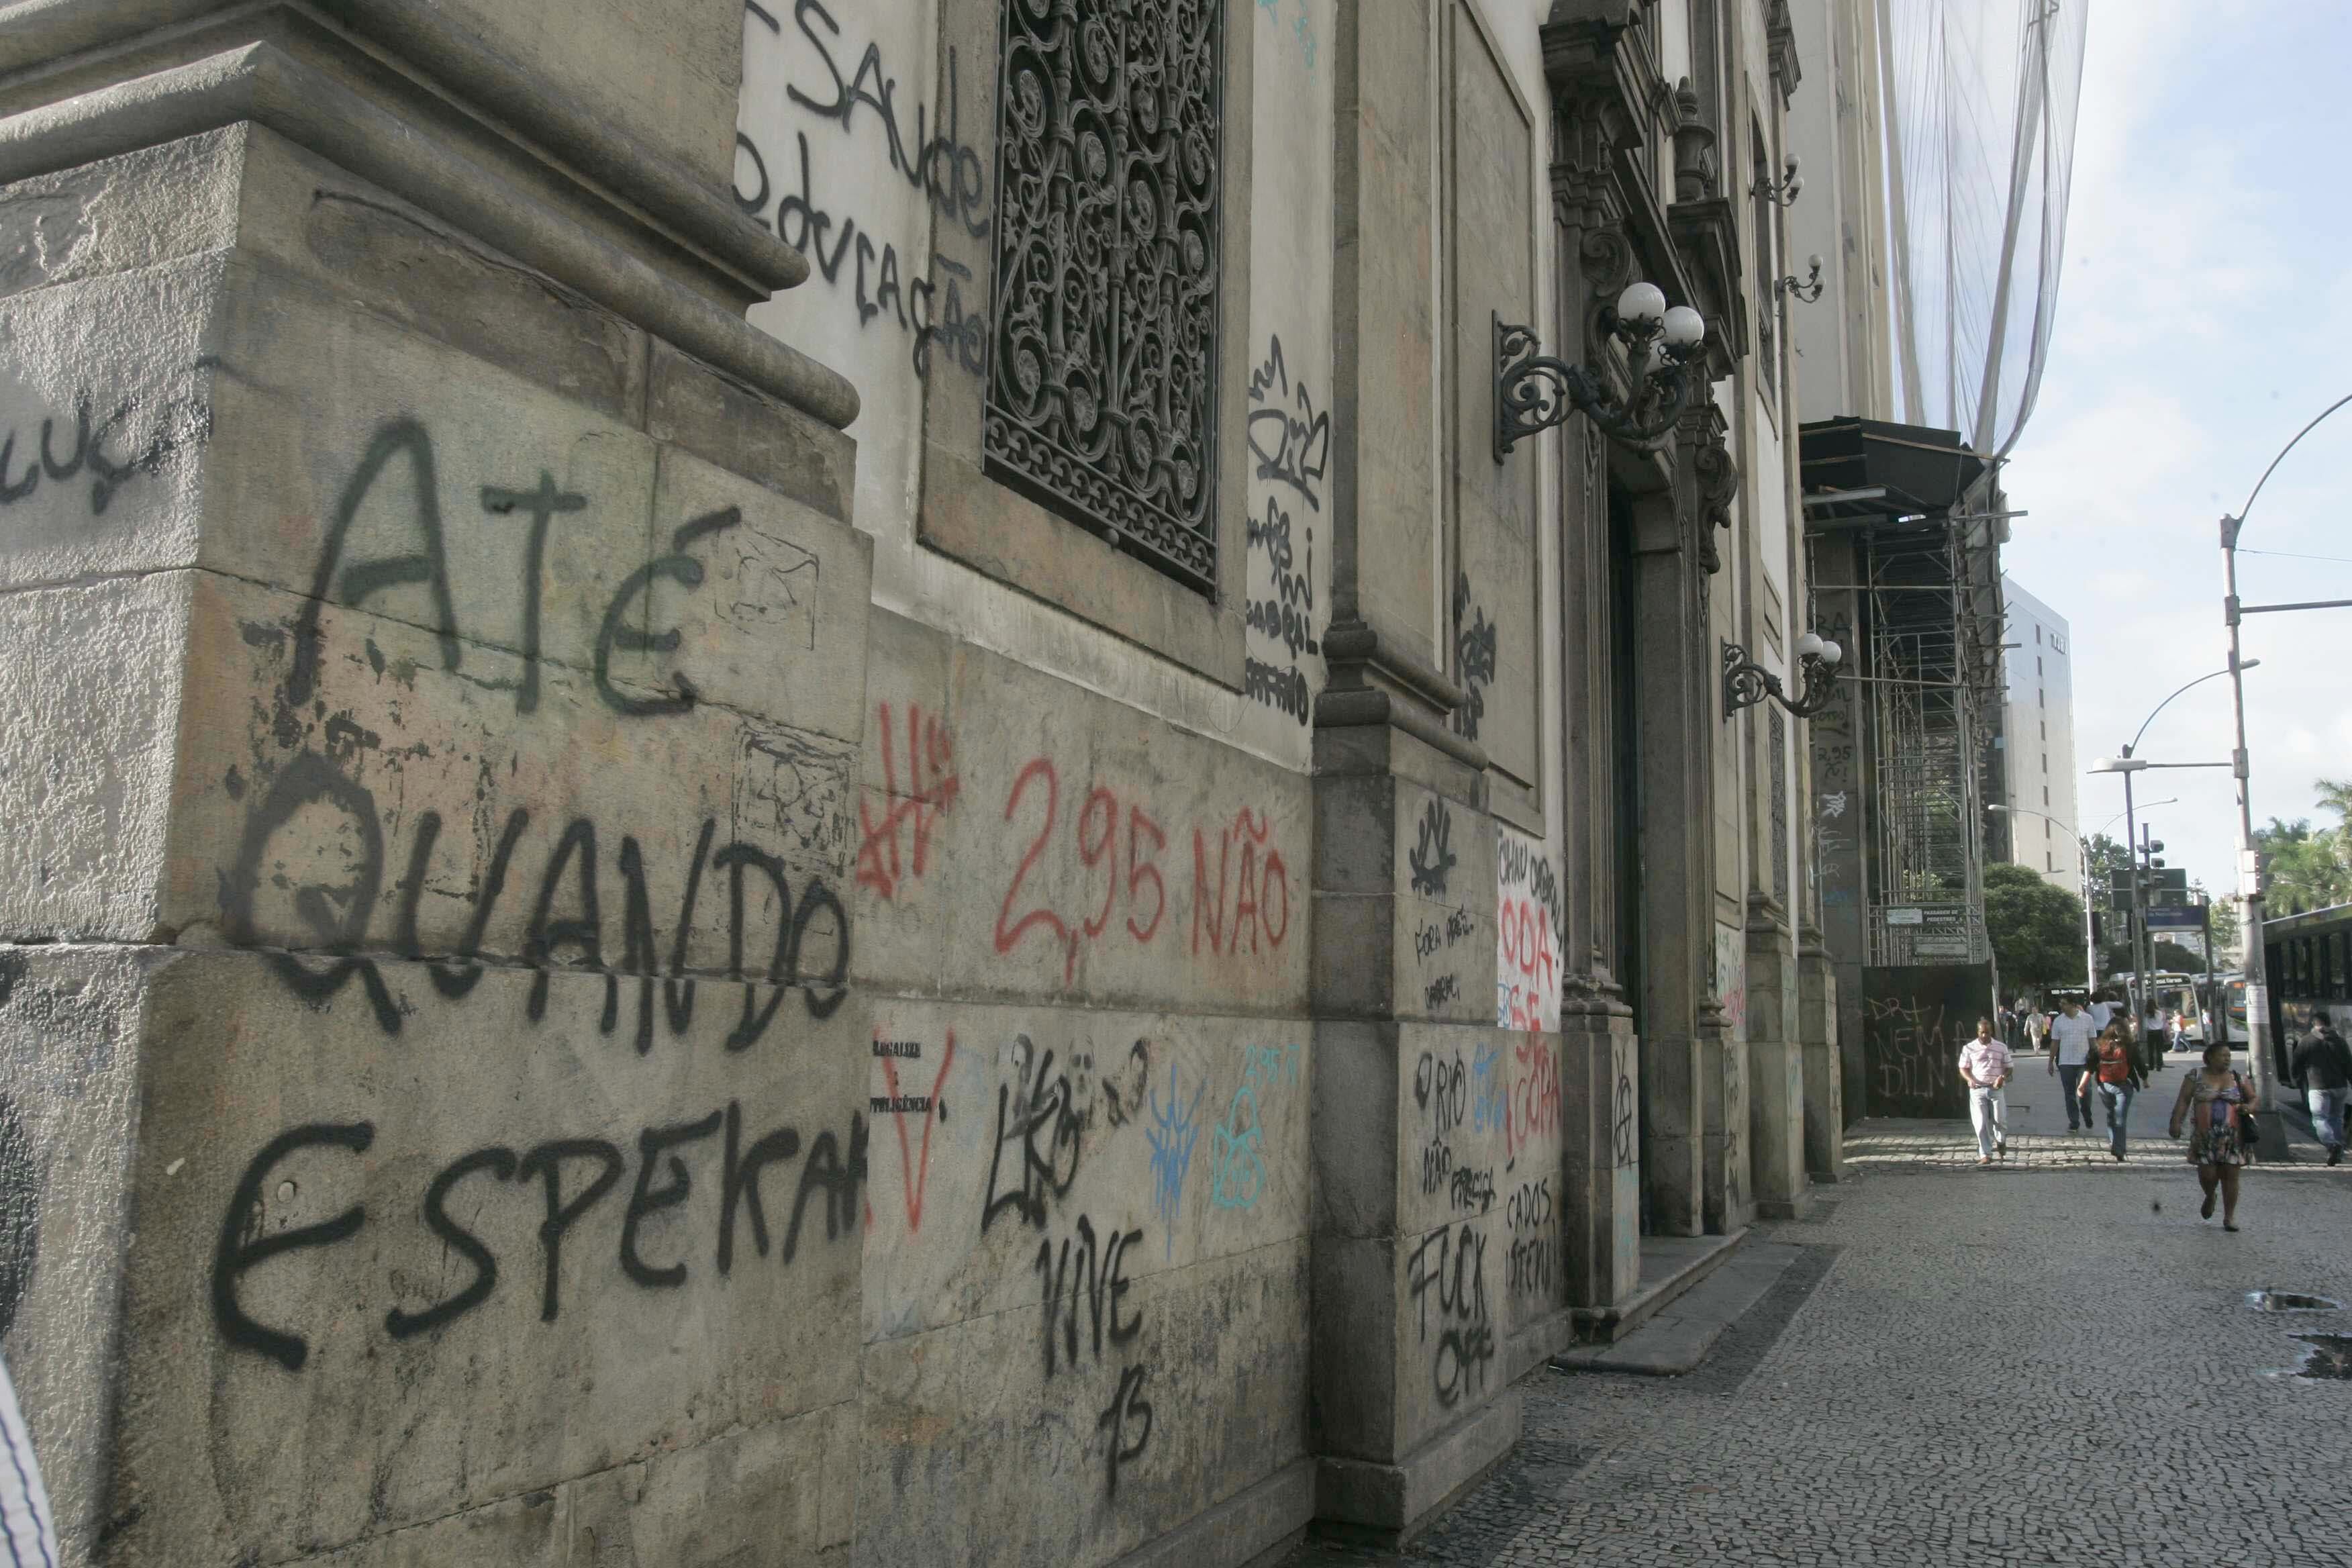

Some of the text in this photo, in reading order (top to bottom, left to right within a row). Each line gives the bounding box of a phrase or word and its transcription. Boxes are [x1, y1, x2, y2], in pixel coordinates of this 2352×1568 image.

[228, 748, 851, 1055] QUANDO
[1193, 805, 1287, 956] NÃO
[1408, 1224, 1487, 1343] FUCK
